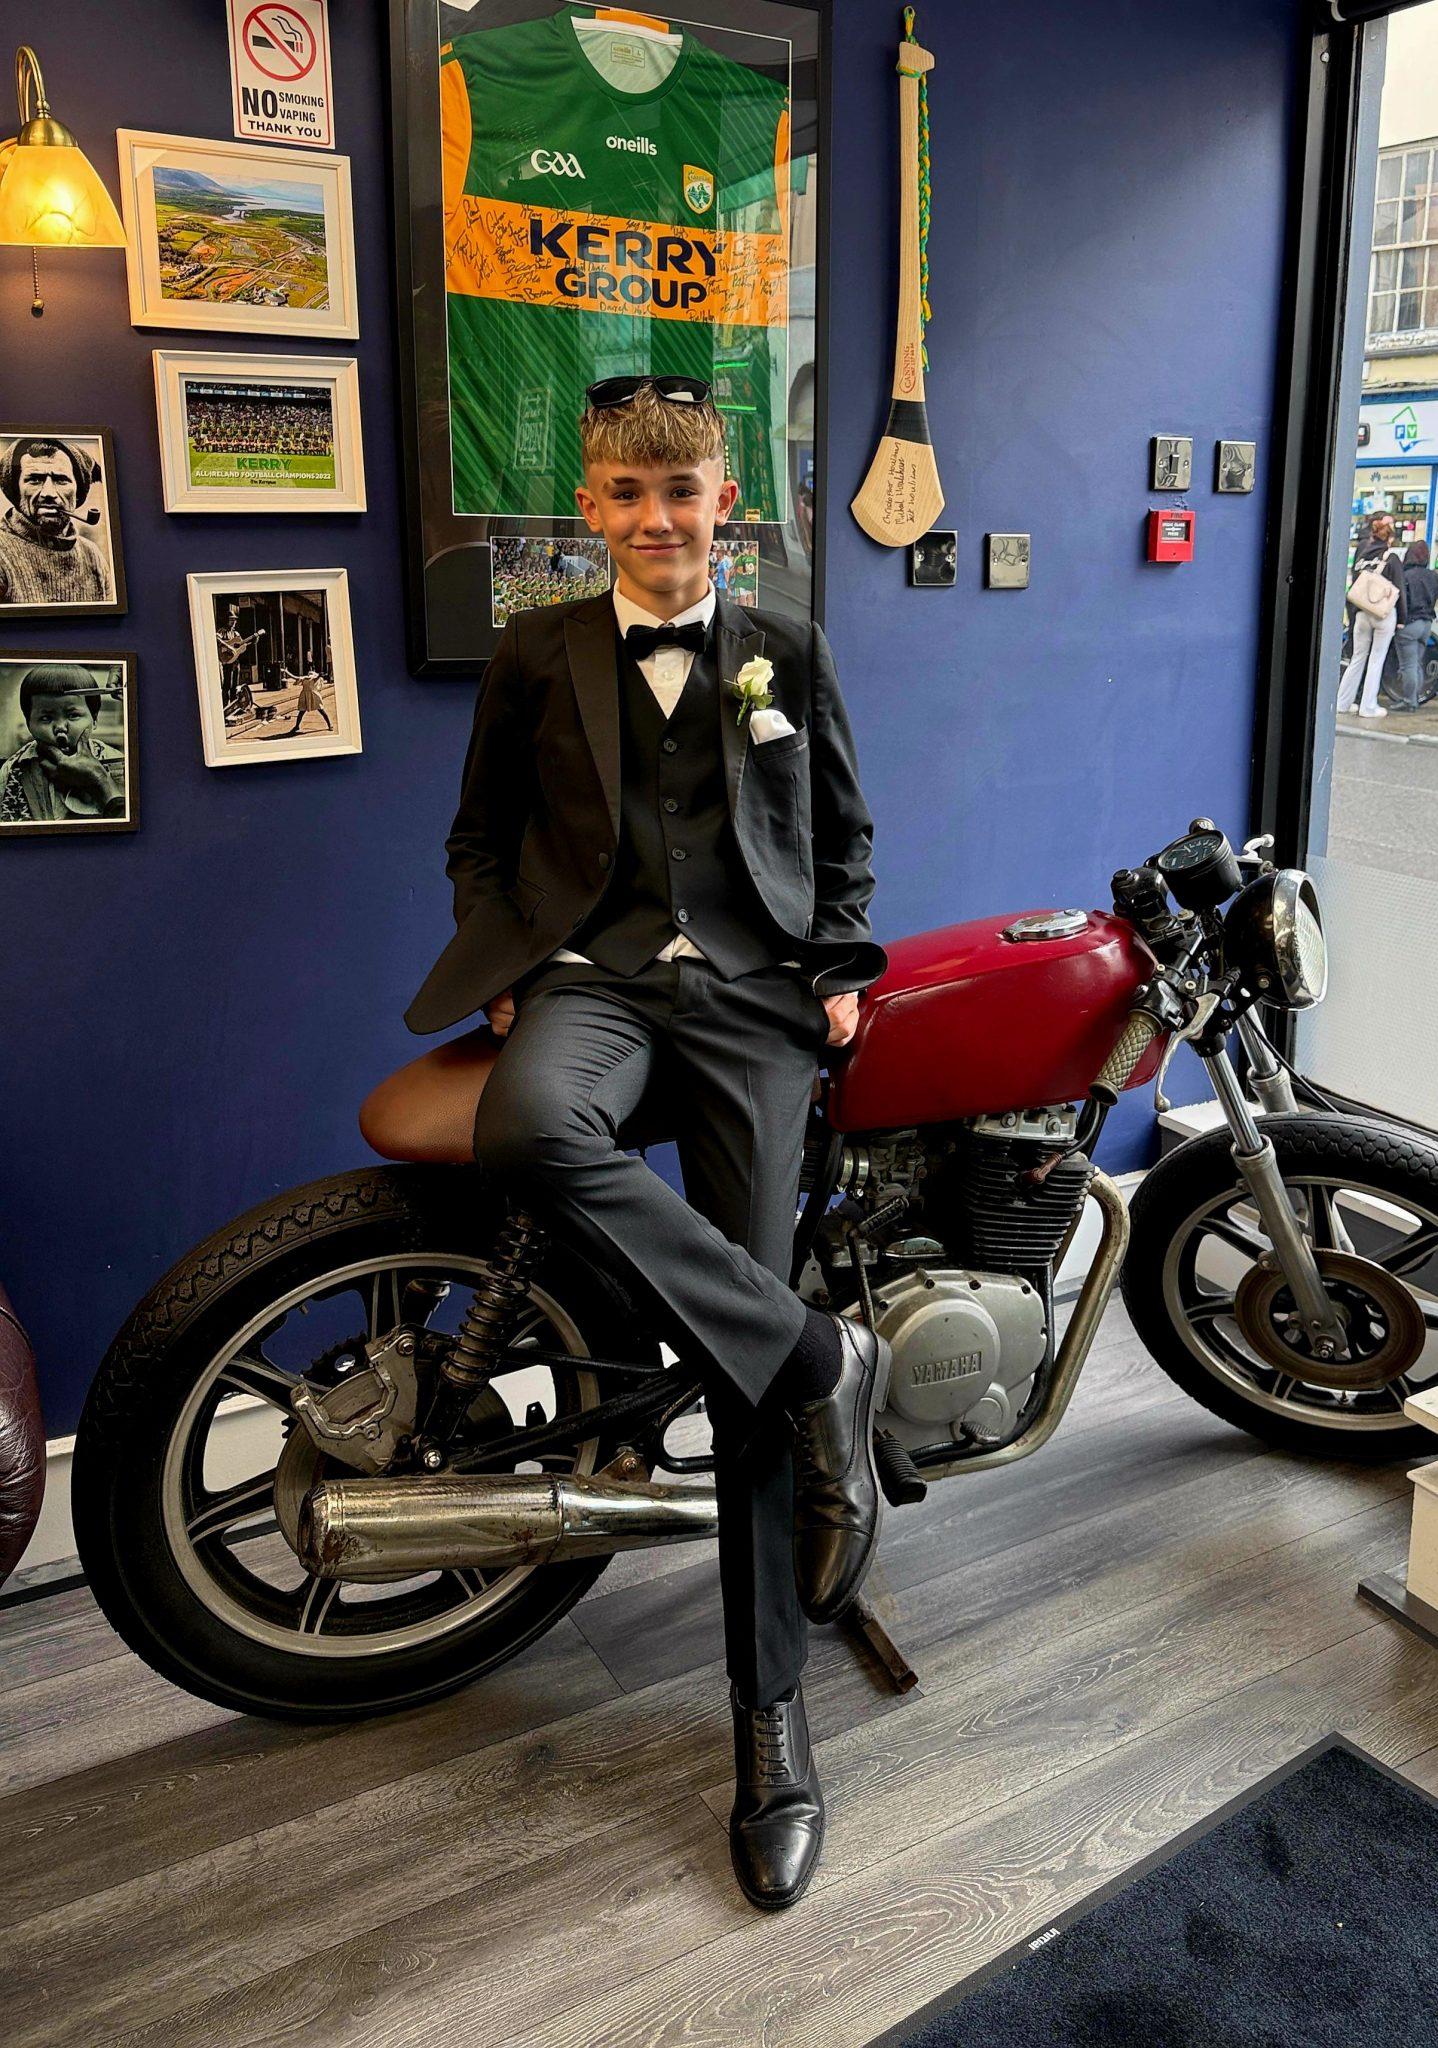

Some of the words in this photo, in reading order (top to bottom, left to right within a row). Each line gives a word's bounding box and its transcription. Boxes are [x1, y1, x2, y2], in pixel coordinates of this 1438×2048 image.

[241, 86, 278, 118] NO
[278, 91, 324, 108] SMOKING
[280, 108, 316, 123] VAPING
[248, 120, 293, 135] THANK
[296, 126, 322, 138] YOU
[530, 218, 728, 277] KERRY
[555, 266, 708, 309] GROUP
[903, 345, 912, 389] CANNING
[195, 469, 240, 478] ALL-IRELAND
[240, 471, 275, 479] FOOTBALL
[275, 471, 316, 480] CHAMPIONS
[236, 457, 292, 471] KERRY
[912, 1351, 982, 1386] YAMAHA
